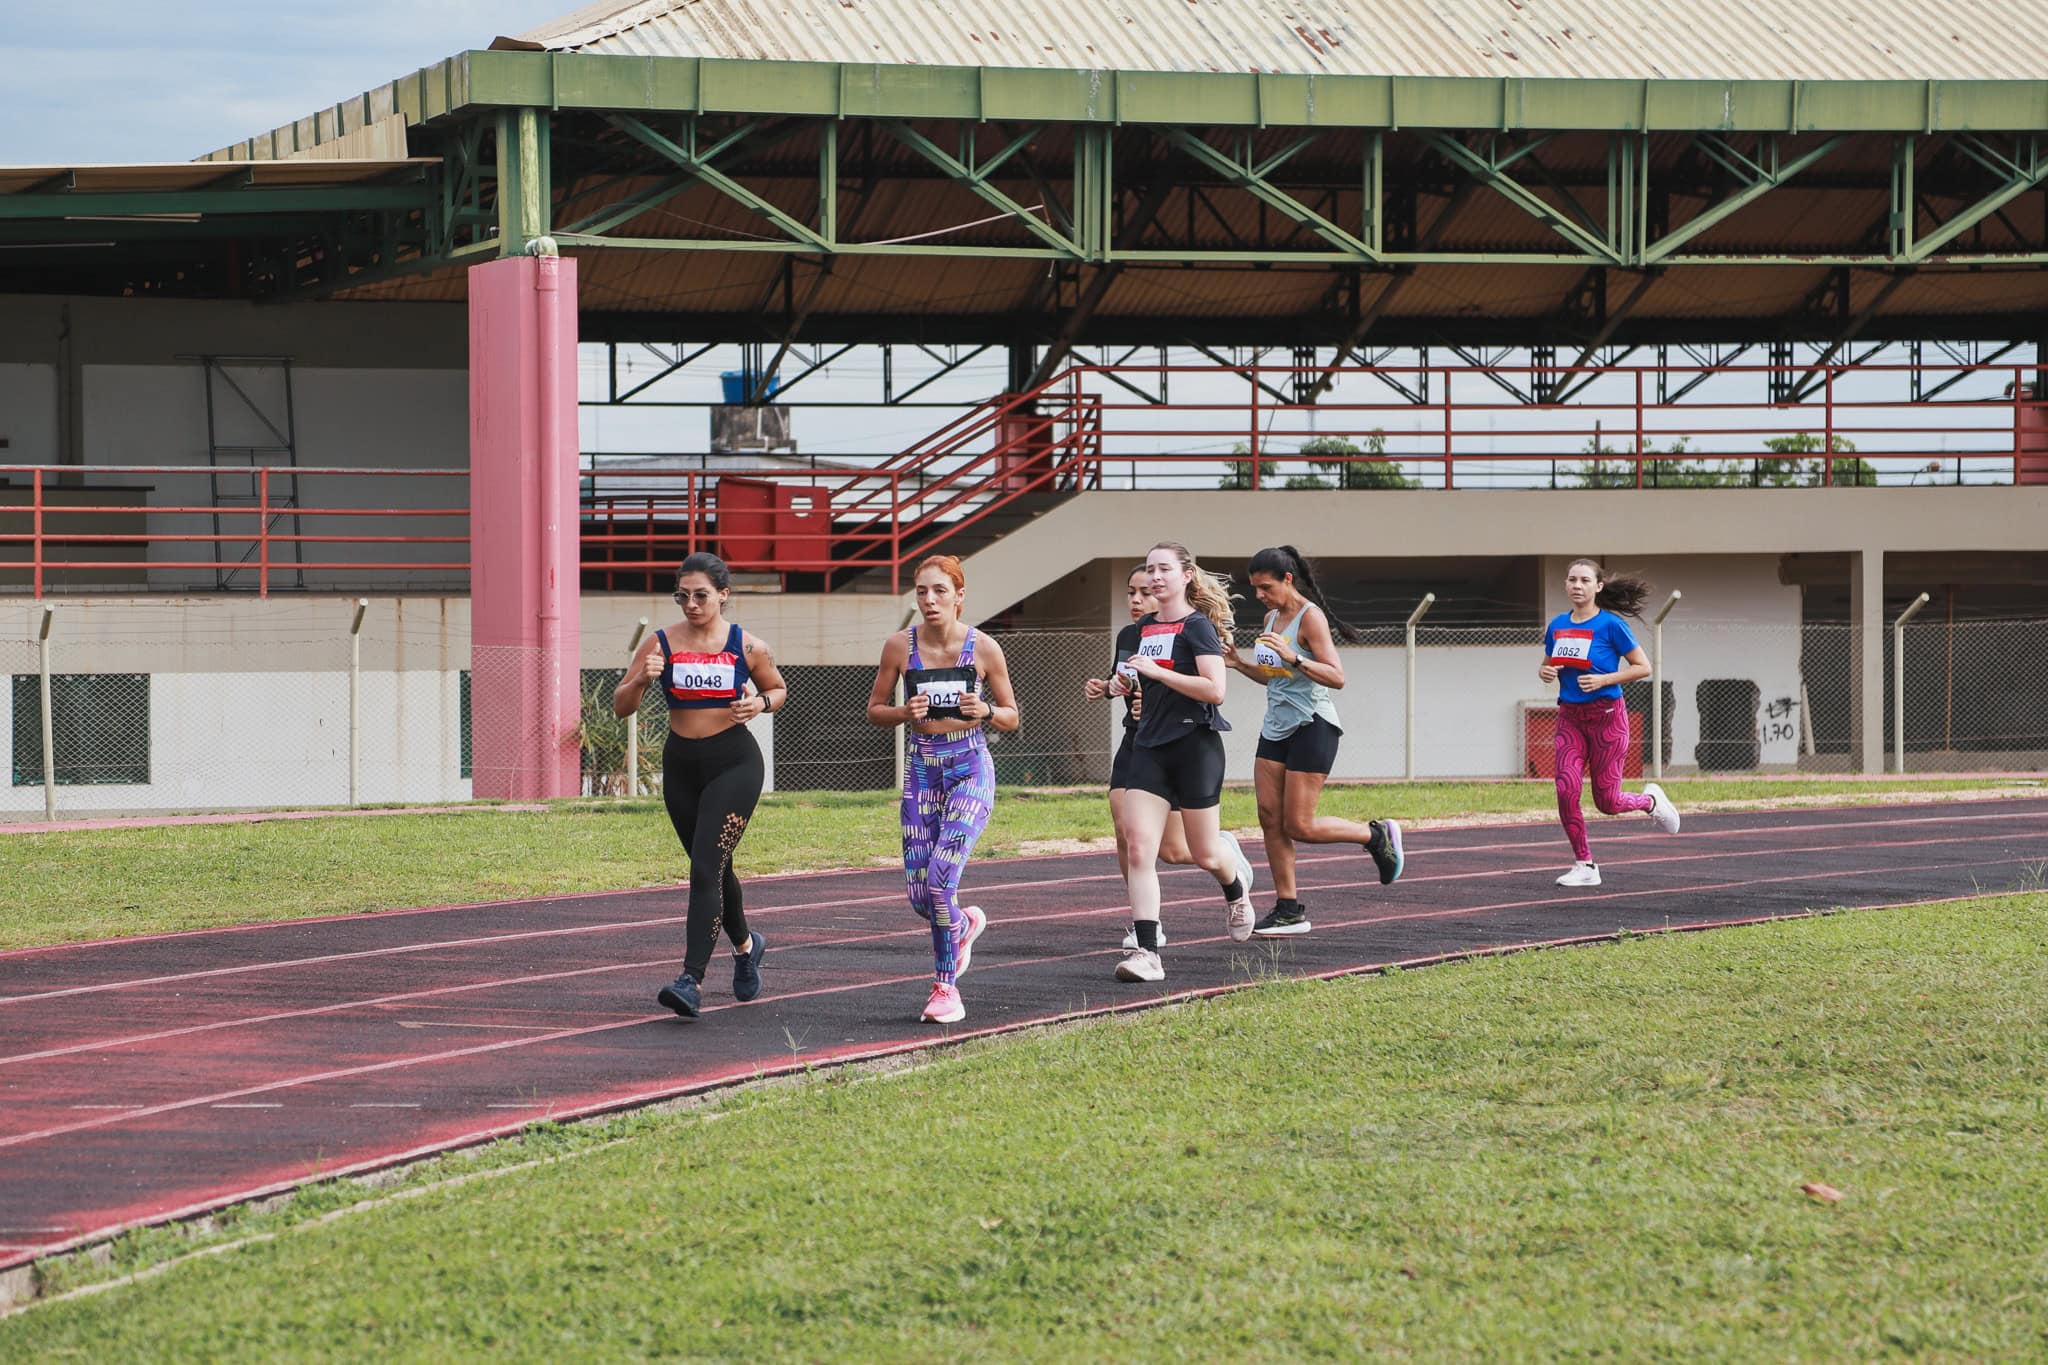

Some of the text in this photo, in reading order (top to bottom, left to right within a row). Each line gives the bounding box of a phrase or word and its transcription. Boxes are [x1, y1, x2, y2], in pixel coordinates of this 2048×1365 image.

[1141, 644, 1163, 656] 0060
[1557, 646, 1580, 657] 0052
[1256, 654, 1274, 666] 0053
[685, 674, 722, 688] 0048
